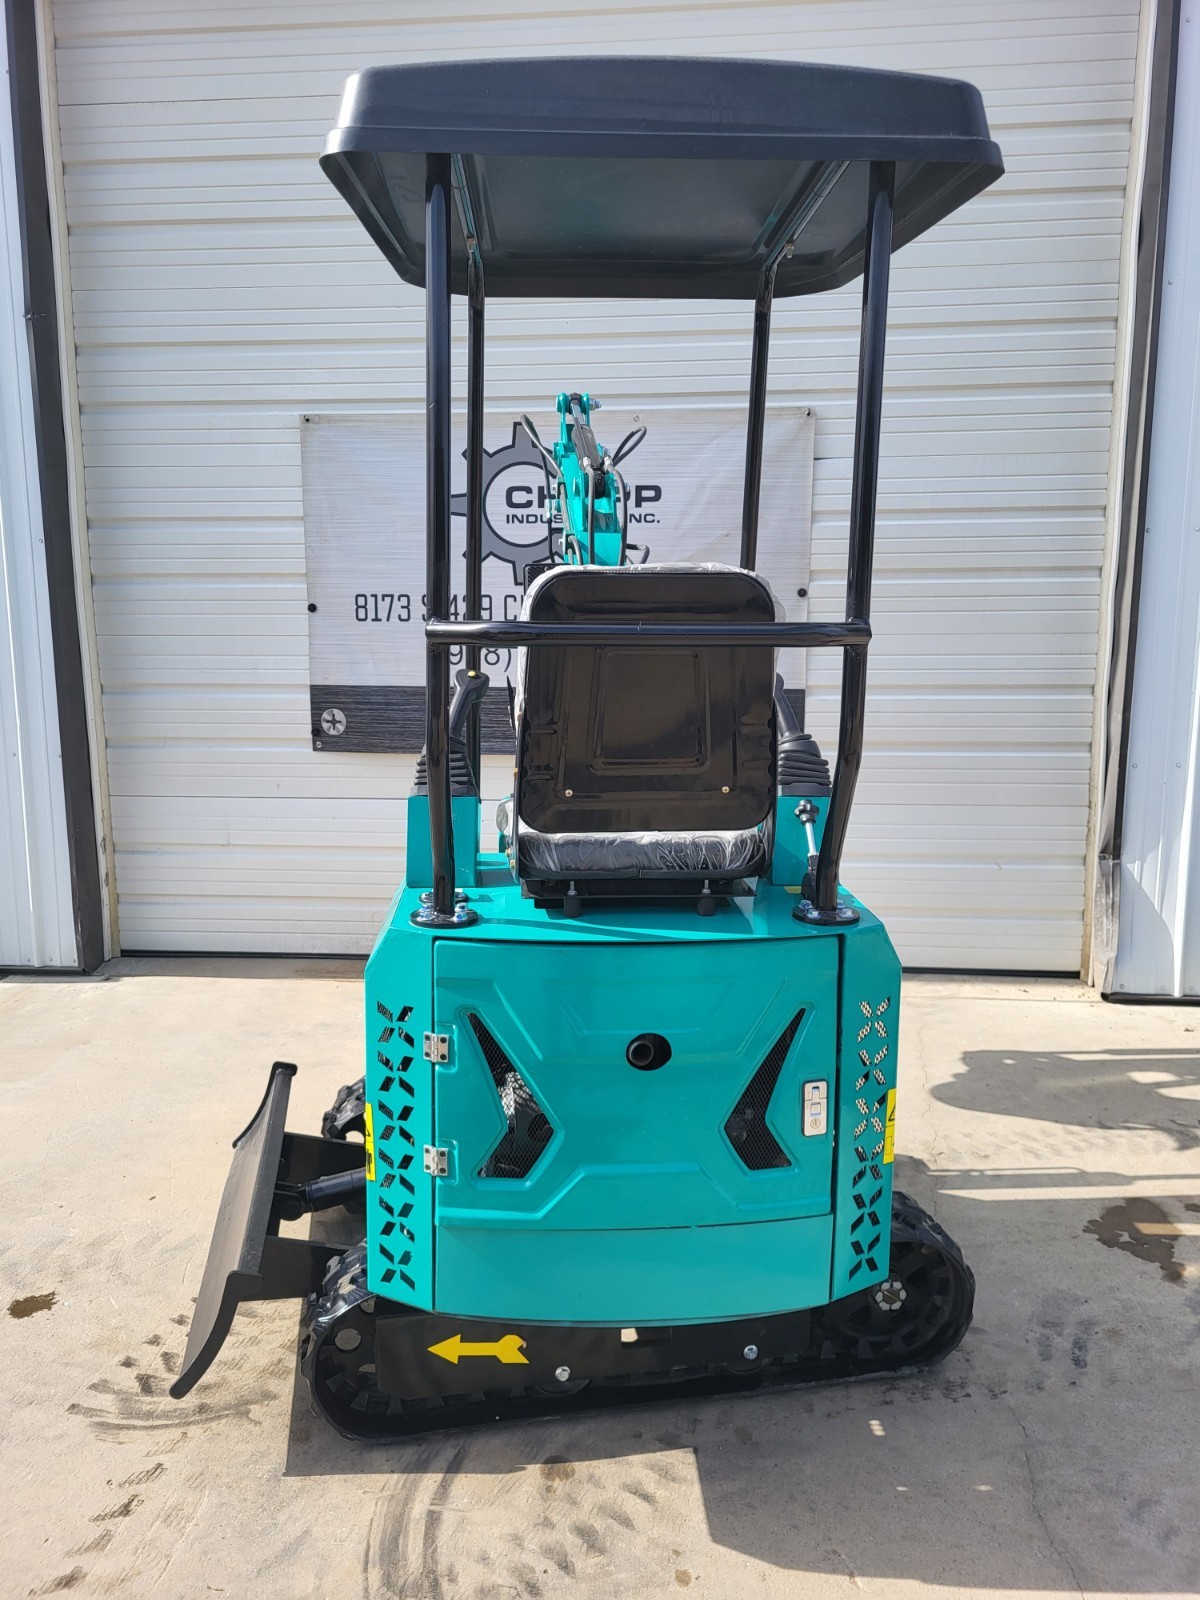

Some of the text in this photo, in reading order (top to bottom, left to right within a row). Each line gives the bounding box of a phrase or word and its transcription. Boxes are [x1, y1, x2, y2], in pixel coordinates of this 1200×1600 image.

[628, 513, 661, 524] NC.
[354, 593, 411, 622] 8173
[449, 594, 493, 621] 49
